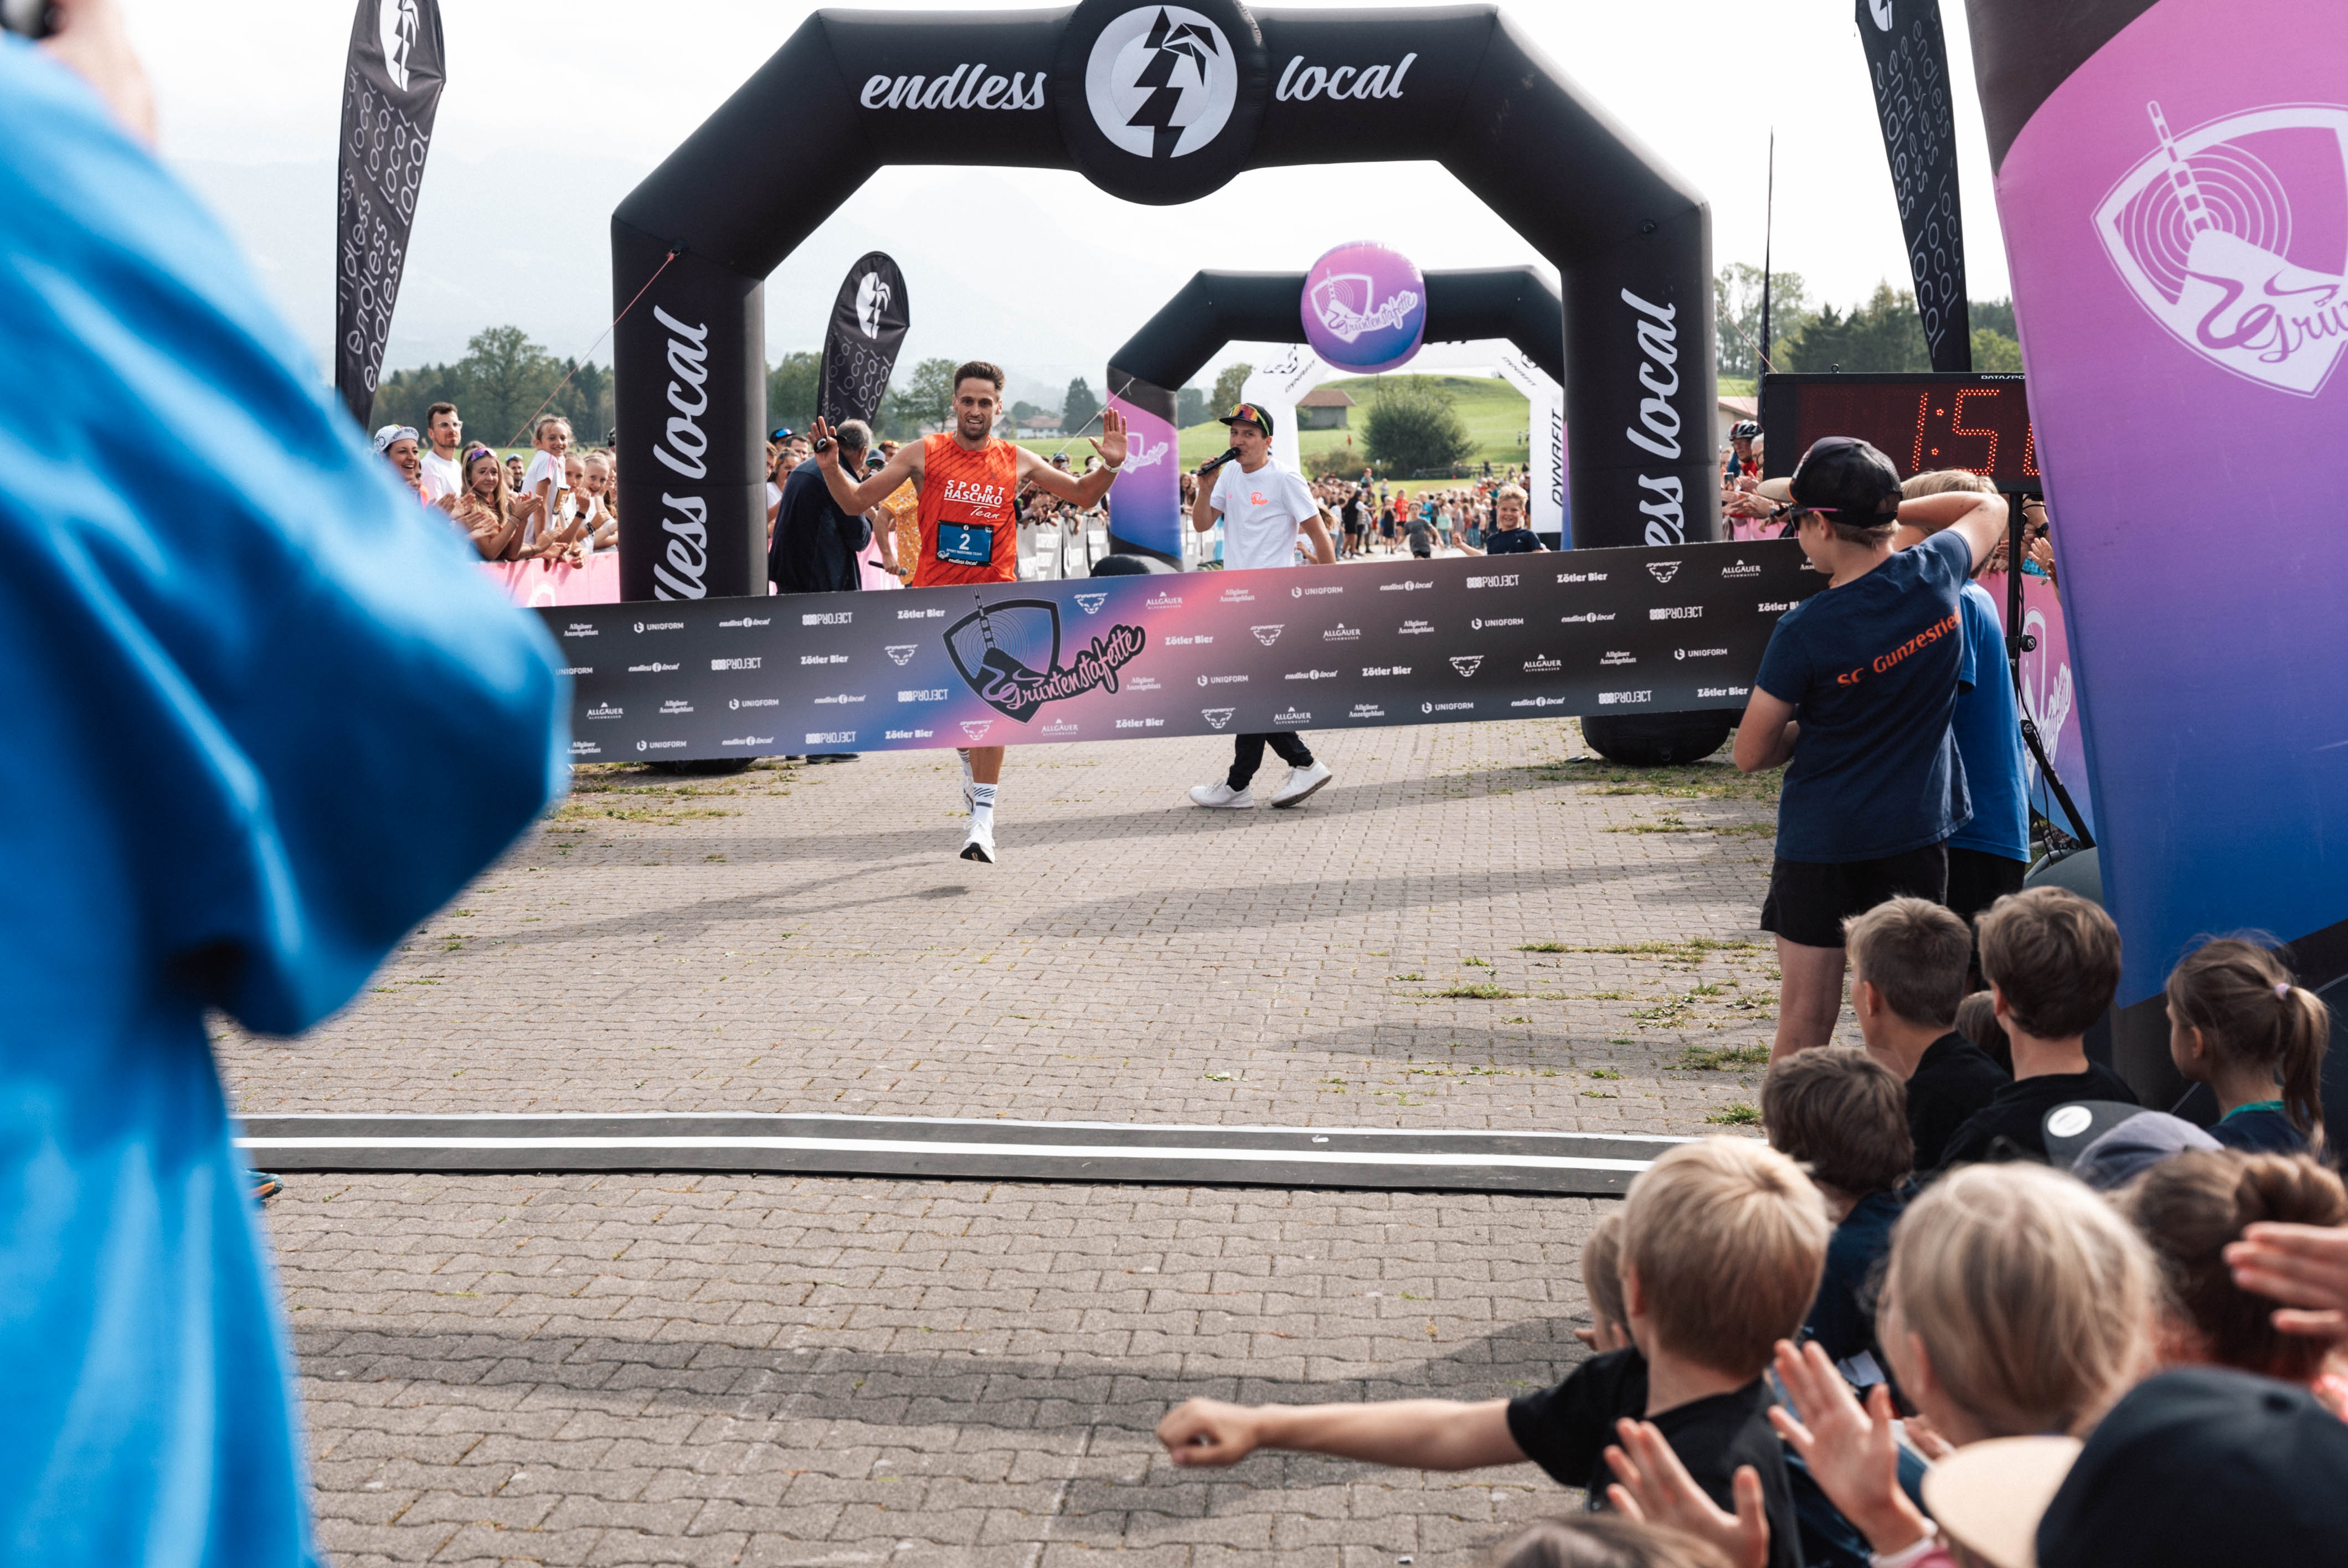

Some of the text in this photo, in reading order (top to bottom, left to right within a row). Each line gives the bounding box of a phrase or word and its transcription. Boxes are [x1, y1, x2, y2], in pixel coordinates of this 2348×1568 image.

[859, 52, 1418, 111] endless local
[1913, 20, 1950, 138] endless
[1901, 35, 1938, 166] endless
[349, 79, 377, 158] local
[1889, 50, 1958, 319] endless local
[339, 193, 371, 316] ndless
[364, 95, 394, 182] local
[1877, 62, 1945, 358] endless local
[347, 109, 411, 355] endless local
[364, 121, 429, 393] endless local
[837, 343, 867, 395] local
[1620, 287, 1682, 460] local
[852, 349, 881, 408] local
[865, 355, 892, 419] local
[1912, 389, 2041, 476] 1:5
[653, 304, 708, 602] less local
[1552, 408, 1563, 508] DYNAFIT
[945, 479, 1005, 497] SPORT
[944, 489, 1003, 506] HASCHKO
[970, 506, 1001, 519] Team
[959, 533, 971, 550] 2
[1722, 565, 1761, 575] ALLGÄUER
[1557, 574, 1587, 583] Zötler
[1380, 583, 1404, 591] endless
[1146, 597, 1182, 606] ALLGÄUER
[1758, 602, 1799, 612] Zötler Bi
[898, 609, 945, 619] Zötler Bier
[1561, 614, 1585, 622] endless
[719, 618, 771, 627] endless local
[1323, 628, 1361, 637] ALLGÄUER
[1165, 635, 1214, 646] Zötler Bier
[1872, 605, 1961, 673] Gunzesried
[801, 655, 848, 665] Zötler Bier
[1523, 659, 1562, 669] ALLGÄUER
[628, 664, 652, 673] endless
[1362, 666, 1412, 677] Zötler Bier
[1285, 671, 1309, 680] endless
[1697, 687, 1748, 697] Zötler Bier
[1511, 699, 1536, 707] endless
[586, 708, 624, 717] ALLGÄUER
[1274, 712, 1311, 721] ALLGÄUER
[1041, 724, 1078, 733] ALLGÄUER
[1115, 718, 1164, 728] Zötler Bier
[885, 730, 933, 740] Zötler Bier
[722, 736, 774, 746] endless local
